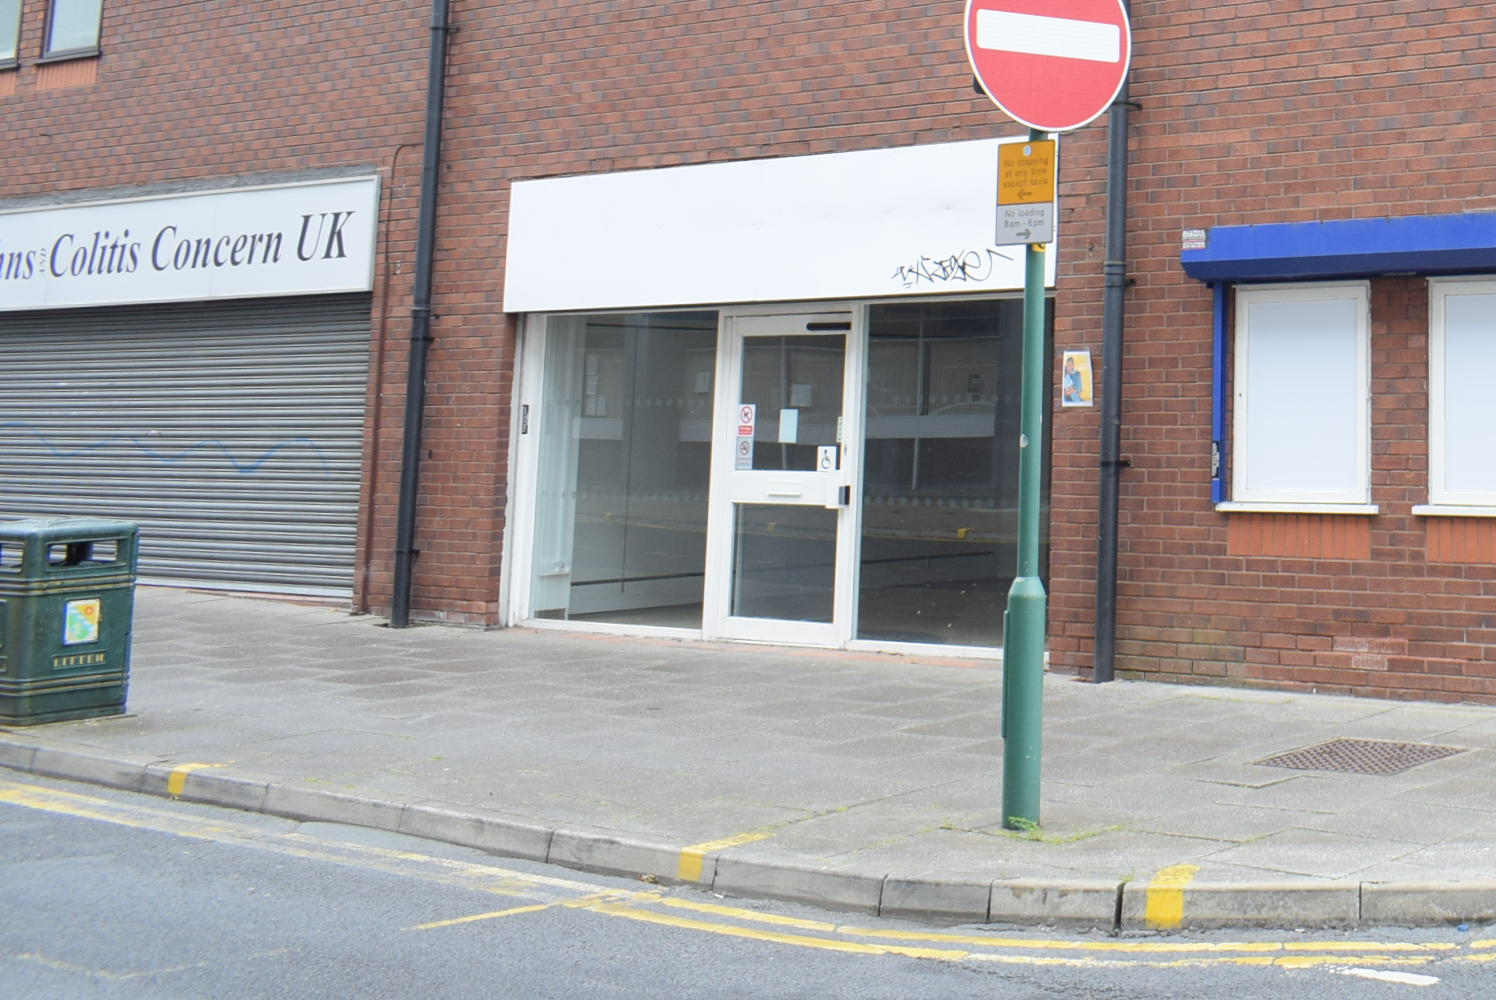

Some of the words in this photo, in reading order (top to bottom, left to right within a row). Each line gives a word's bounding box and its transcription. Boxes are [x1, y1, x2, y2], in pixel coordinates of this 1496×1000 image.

[0, 250, 36, 280] ns
[49, 228, 141, 278] Colitis
[151, 225, 283, 272] Concern
[297, 210, 356, 262] UK
[53, 653, 105, 667] LITTER
